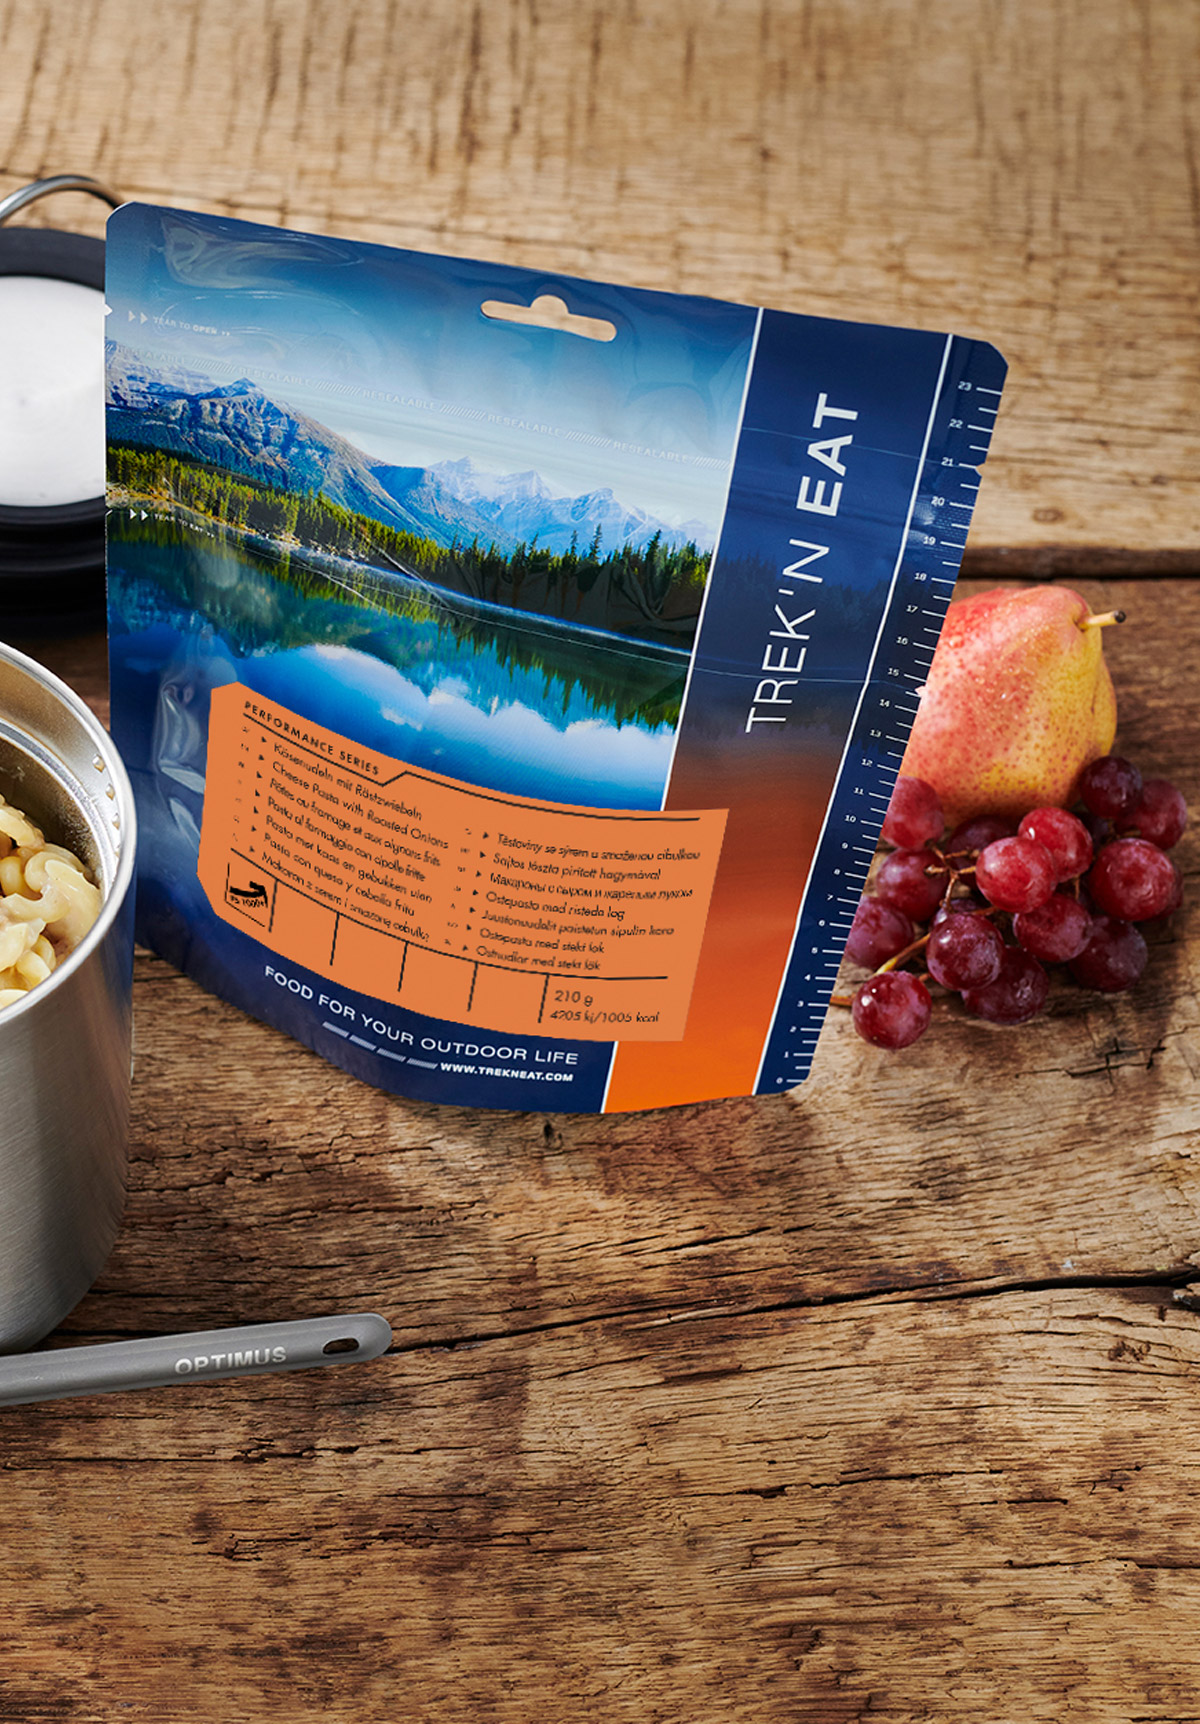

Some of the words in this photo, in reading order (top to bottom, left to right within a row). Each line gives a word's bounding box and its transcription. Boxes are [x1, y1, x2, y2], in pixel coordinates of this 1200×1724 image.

[179, 321, 190, 330] TO
[193, 325, 217, 334] OPEN
[958, 381, 971, 391] 23
[362, 389, 438, 410] RESEALABLE
[487, 414, 562, 437] RESEALABLE
[948, 419, 963, 428] 22
[613, 440, 689, 464] RESEALABLE
[796, 392, 858, 516] EAT
[941, 457, 953, 467] 21
[931, 497, 944, 506] 20
[923, 536, 936, 546] 19
[914, 572, 927, 581] 18
[906, 605, 918, 613] 17
[896, 637, 908, 646] 16
[888, 668, 899, 677] 15
[880, 699, 890, 708] 14
[244, 701, 334, 755] PERFORMANCE
[339, 751, 379, 775] SERIES
[870, 729, 881, 738] 13
[862, 758, 872, 767] 12
[337, 777, 352, 792] mit
[854, 787, 864, 795] 11
[272, 762, 310, 789] Cheese
[313, 785, 339, 805] Pasta
[343, 798, 364, 817] with
[367, 811, 407, 835] Roasted
[410, 828, 449, 849] Onions
[845, 815, 856, 823] 10
[268, 796, 293, 822] Pasta
[355, 846, 372, 860] con
[266, 815, 294, 839] Pasta
[343, 861, 355, 872] en
[264, 833, 290, 856] Pasta
[294, 853, 311, 867] con
[345, 880, 353, 892] y
[493, 853, 524, 870] Sajtos
[555, 990, 580, 1003] 210
[584, 995, 593, 1007] g
[264, 965, 313, 999] FOOD
[318, 994, 356, 1022] FOR
[361, 1014, 414, 1046] YOUR
[421, 1038, 528, 1061] OUTDOOR
[534, 1051, 579, 1065] LIFE
[440, 1062, 574, 1082] WWW.TREKNEAT.COM
[174, 1346, 287, 1374] OPTIMUS
